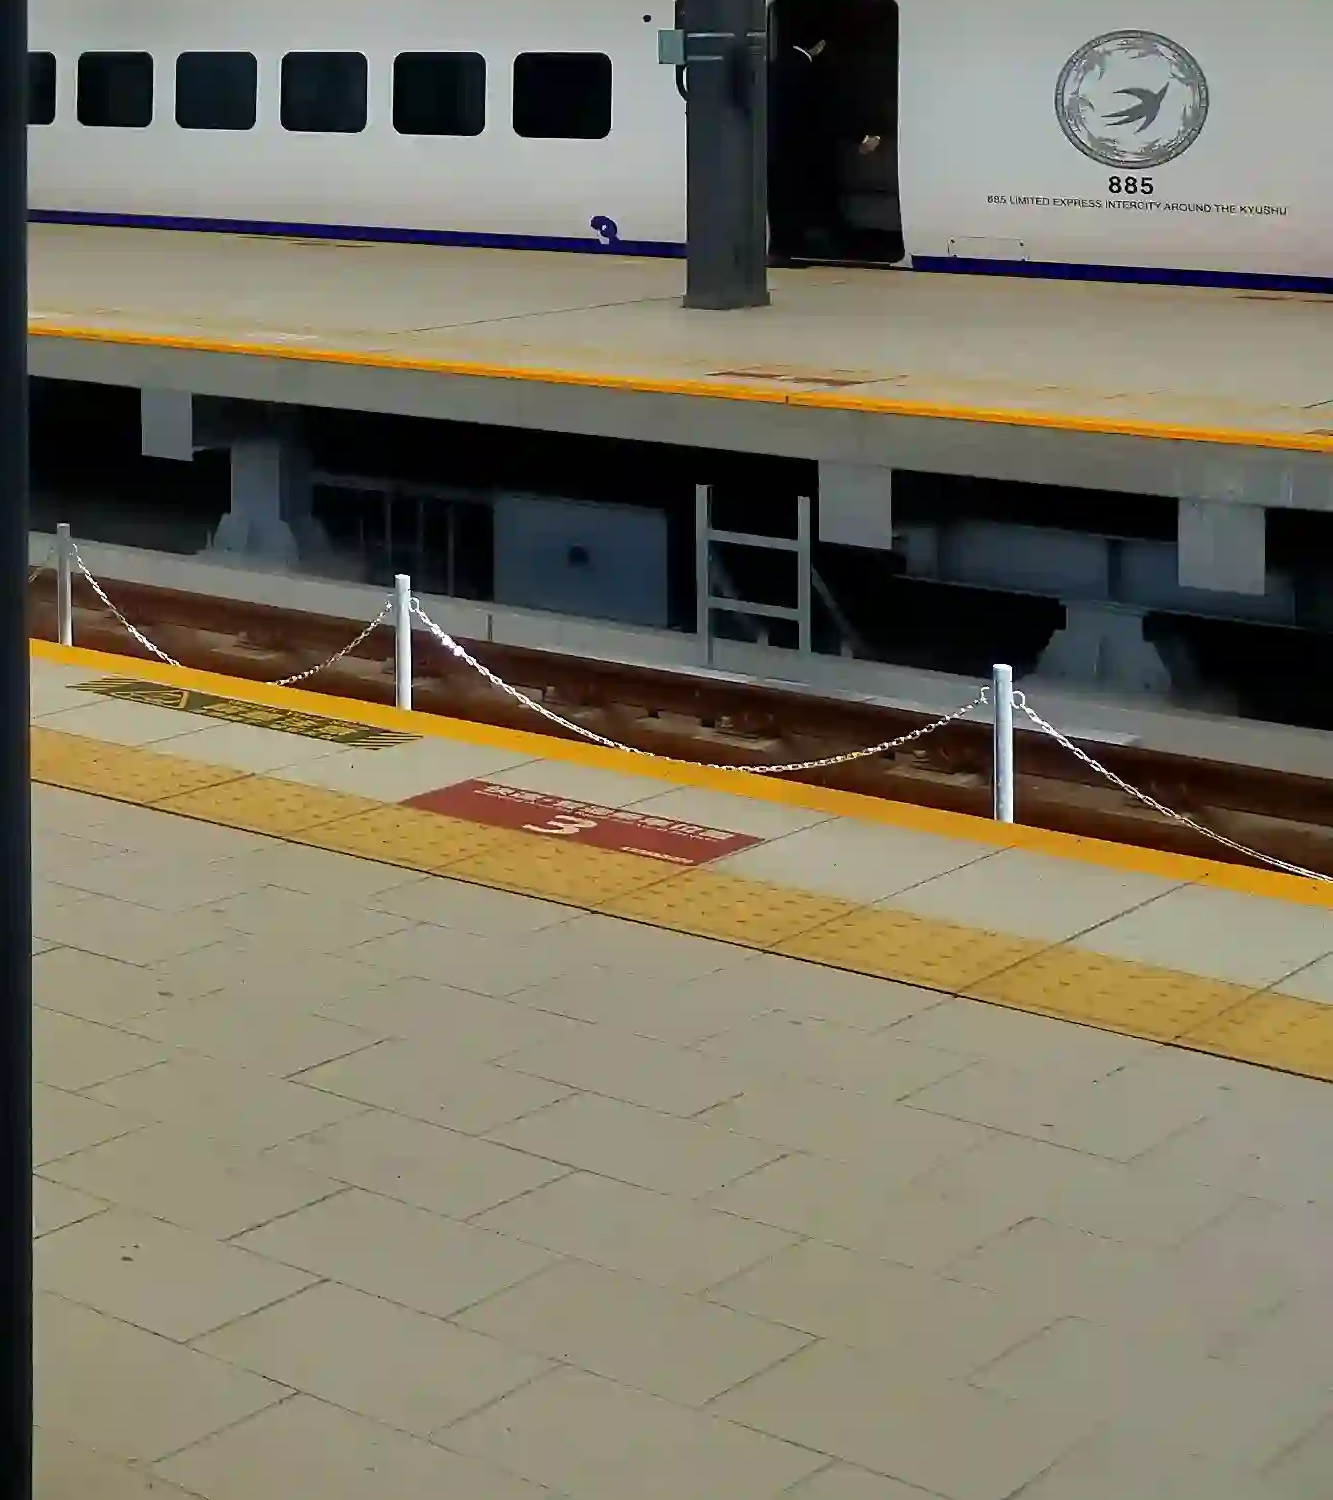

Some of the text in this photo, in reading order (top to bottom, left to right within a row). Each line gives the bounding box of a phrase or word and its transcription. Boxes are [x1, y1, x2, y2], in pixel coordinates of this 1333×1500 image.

[1108, 176, 1154, 195] 885
[1009, 196, 1050, 206] LIMITED
[1053, 198, 1102, 208] EXPRESS
[1105, 200, 1162, 211] INTERCITY
[1164, 202, 1211, 213] AROUND
[1214, 204, 1236, 214] THE
[1240, 205, 1288, 216] KYUSHU
[522, 815, 598, 834] 3
